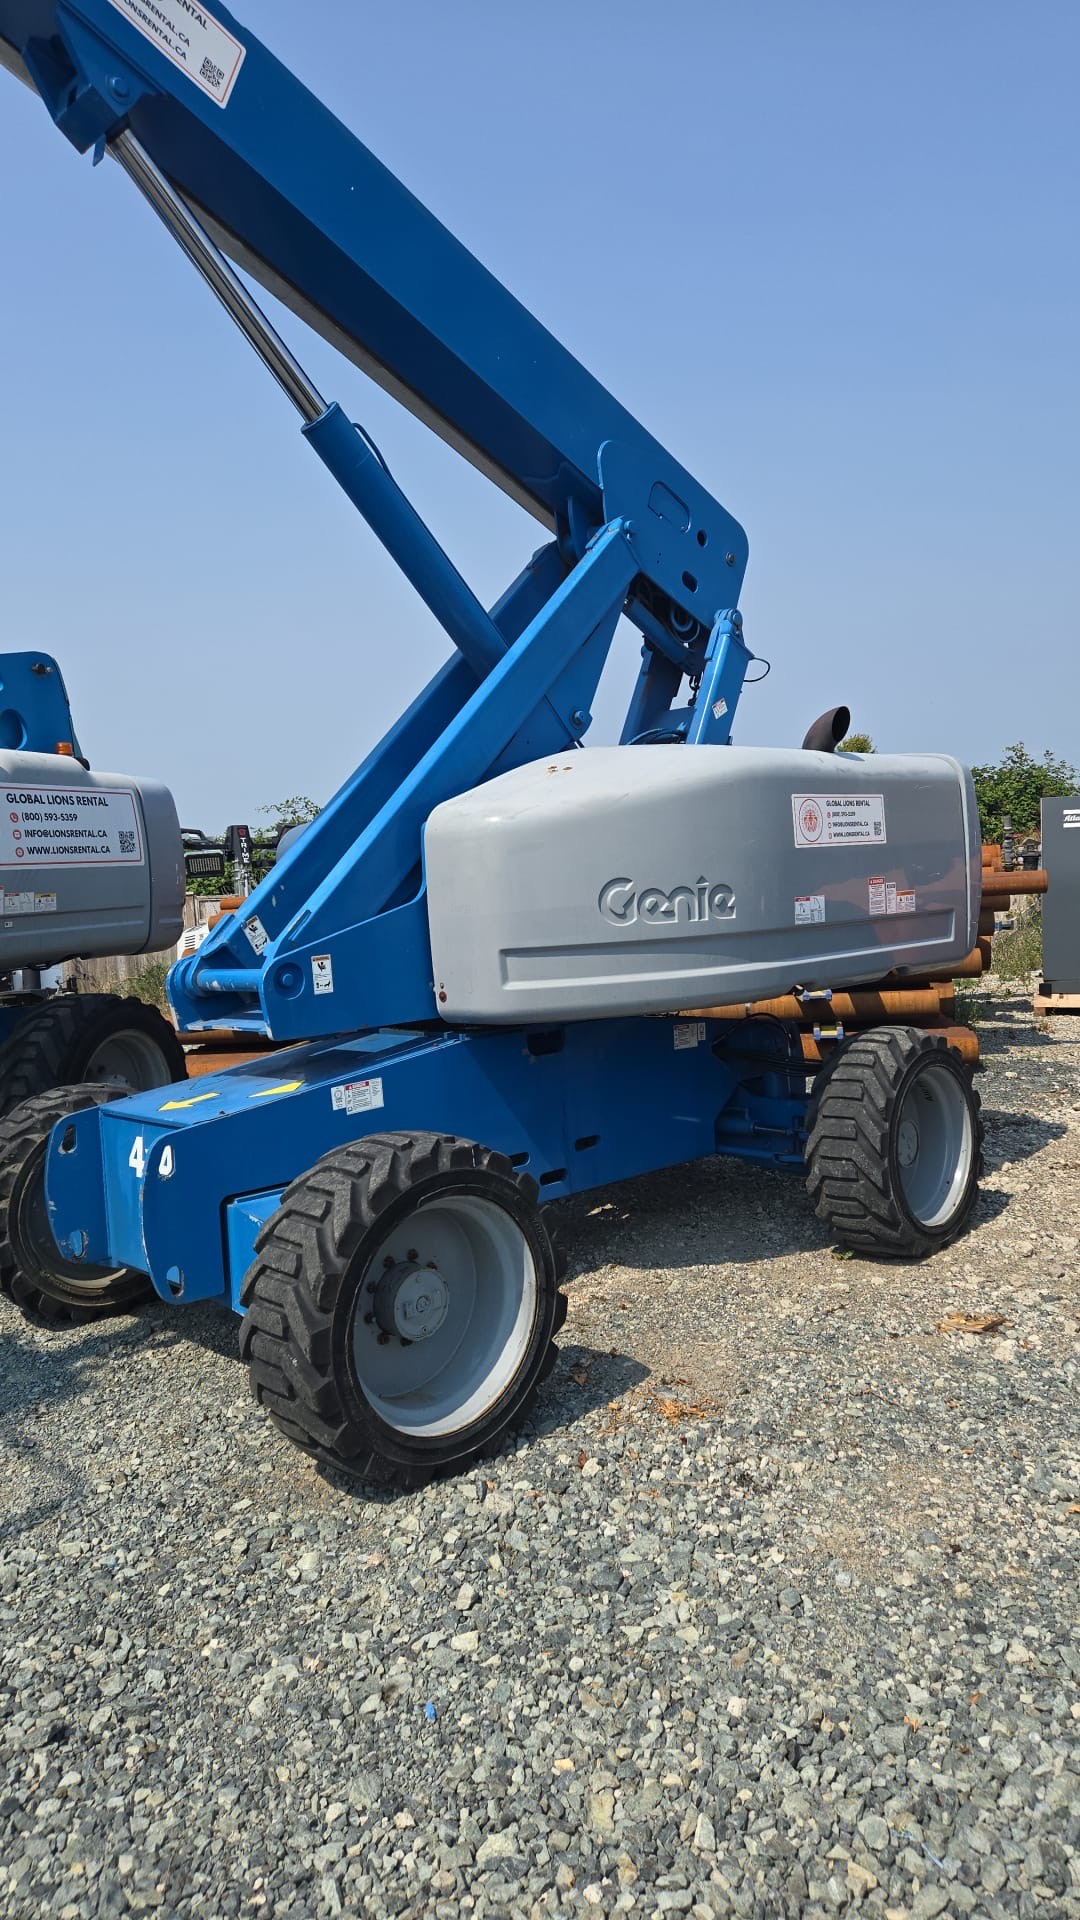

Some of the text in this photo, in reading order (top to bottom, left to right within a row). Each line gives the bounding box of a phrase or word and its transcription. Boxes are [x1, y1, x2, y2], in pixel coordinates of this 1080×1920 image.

[6, 793, 109, 807] GLOBAL LIONS RENTAL
[22, 812, 78, 823] (800) 593-5359
[24, 829, 108, 838] INFO@LIONSRENTAL.CA
[26, 845, 111, 855] WWW.LIONSRENTAL.CA
[239, 837, 250, 864] TRIME
[598, 875, 737, 927] Genie
